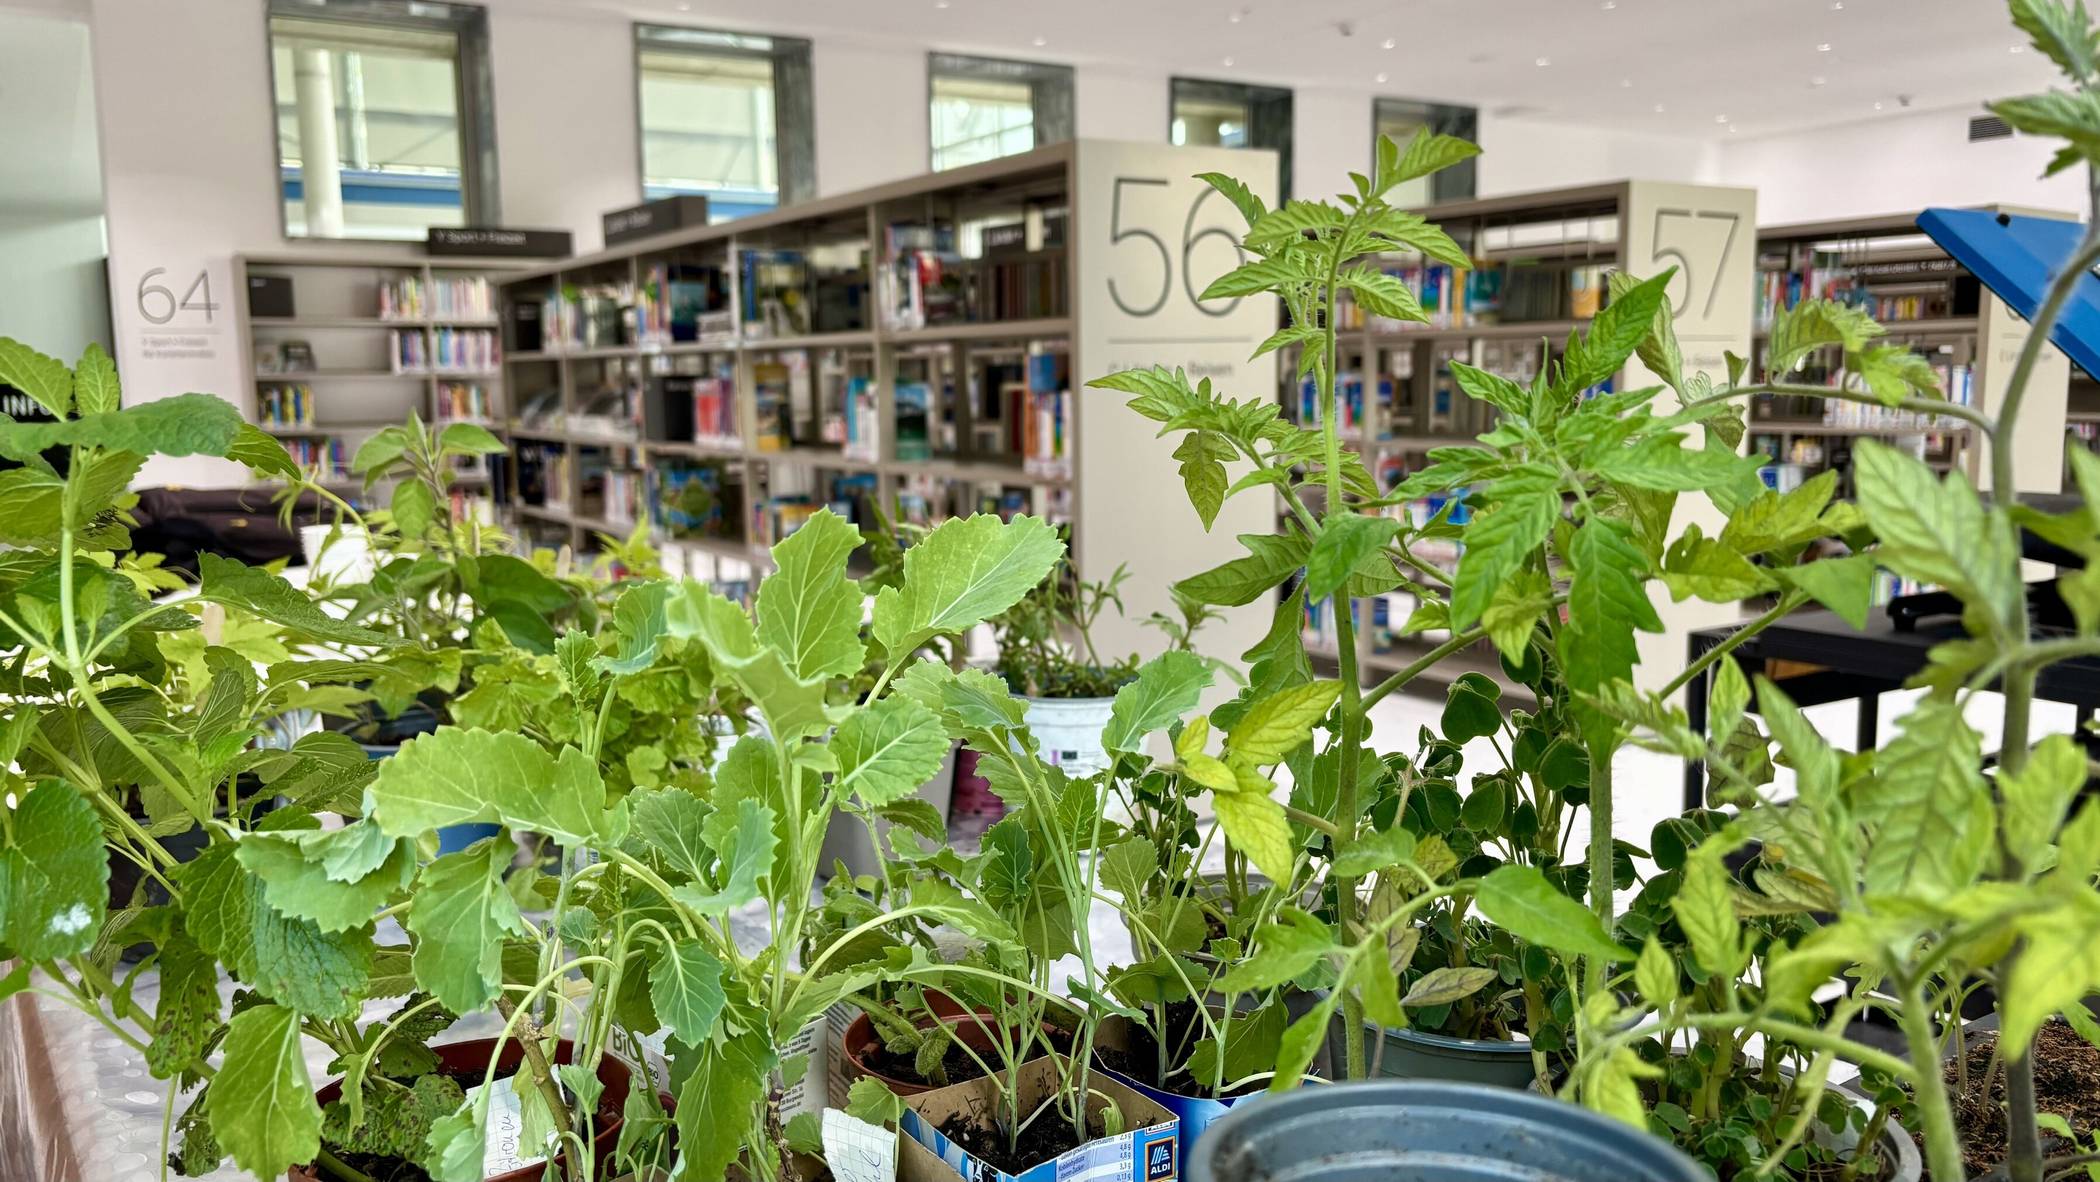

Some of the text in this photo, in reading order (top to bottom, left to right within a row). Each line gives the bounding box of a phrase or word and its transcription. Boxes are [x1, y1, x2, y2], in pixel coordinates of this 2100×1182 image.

[1107, 177, 1246, 318] 56
[1651, 208, 1739, 321] 57
[137, 266, 220, 325] 64
[1150, 1164, 1171, 1175] ALDI
